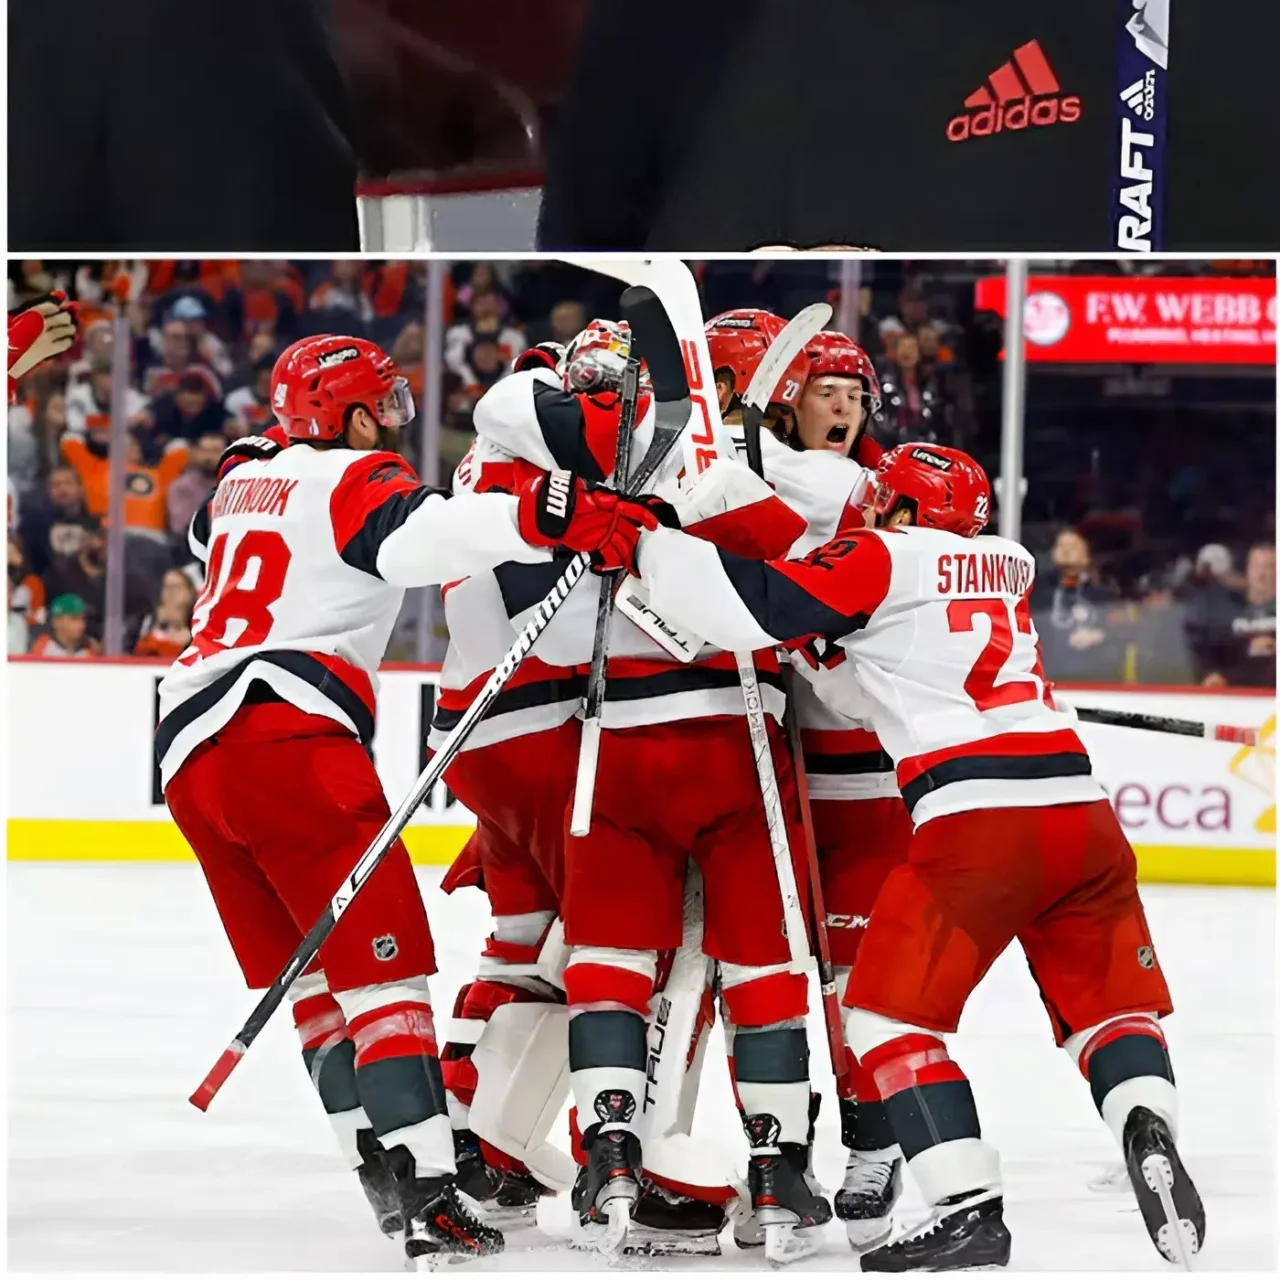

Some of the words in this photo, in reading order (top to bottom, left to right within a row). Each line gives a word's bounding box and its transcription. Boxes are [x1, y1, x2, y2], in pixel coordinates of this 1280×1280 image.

[946, 95, 1081, 142] adidas
[1117, 118, 1155, 252] RAFT
[1155, 292, 1261, 325] WEBB
[681, 338, 718, 476] RUE
[1114, 784, 1232, 832] eca
[642, 996, 673, 1114] TRUE
